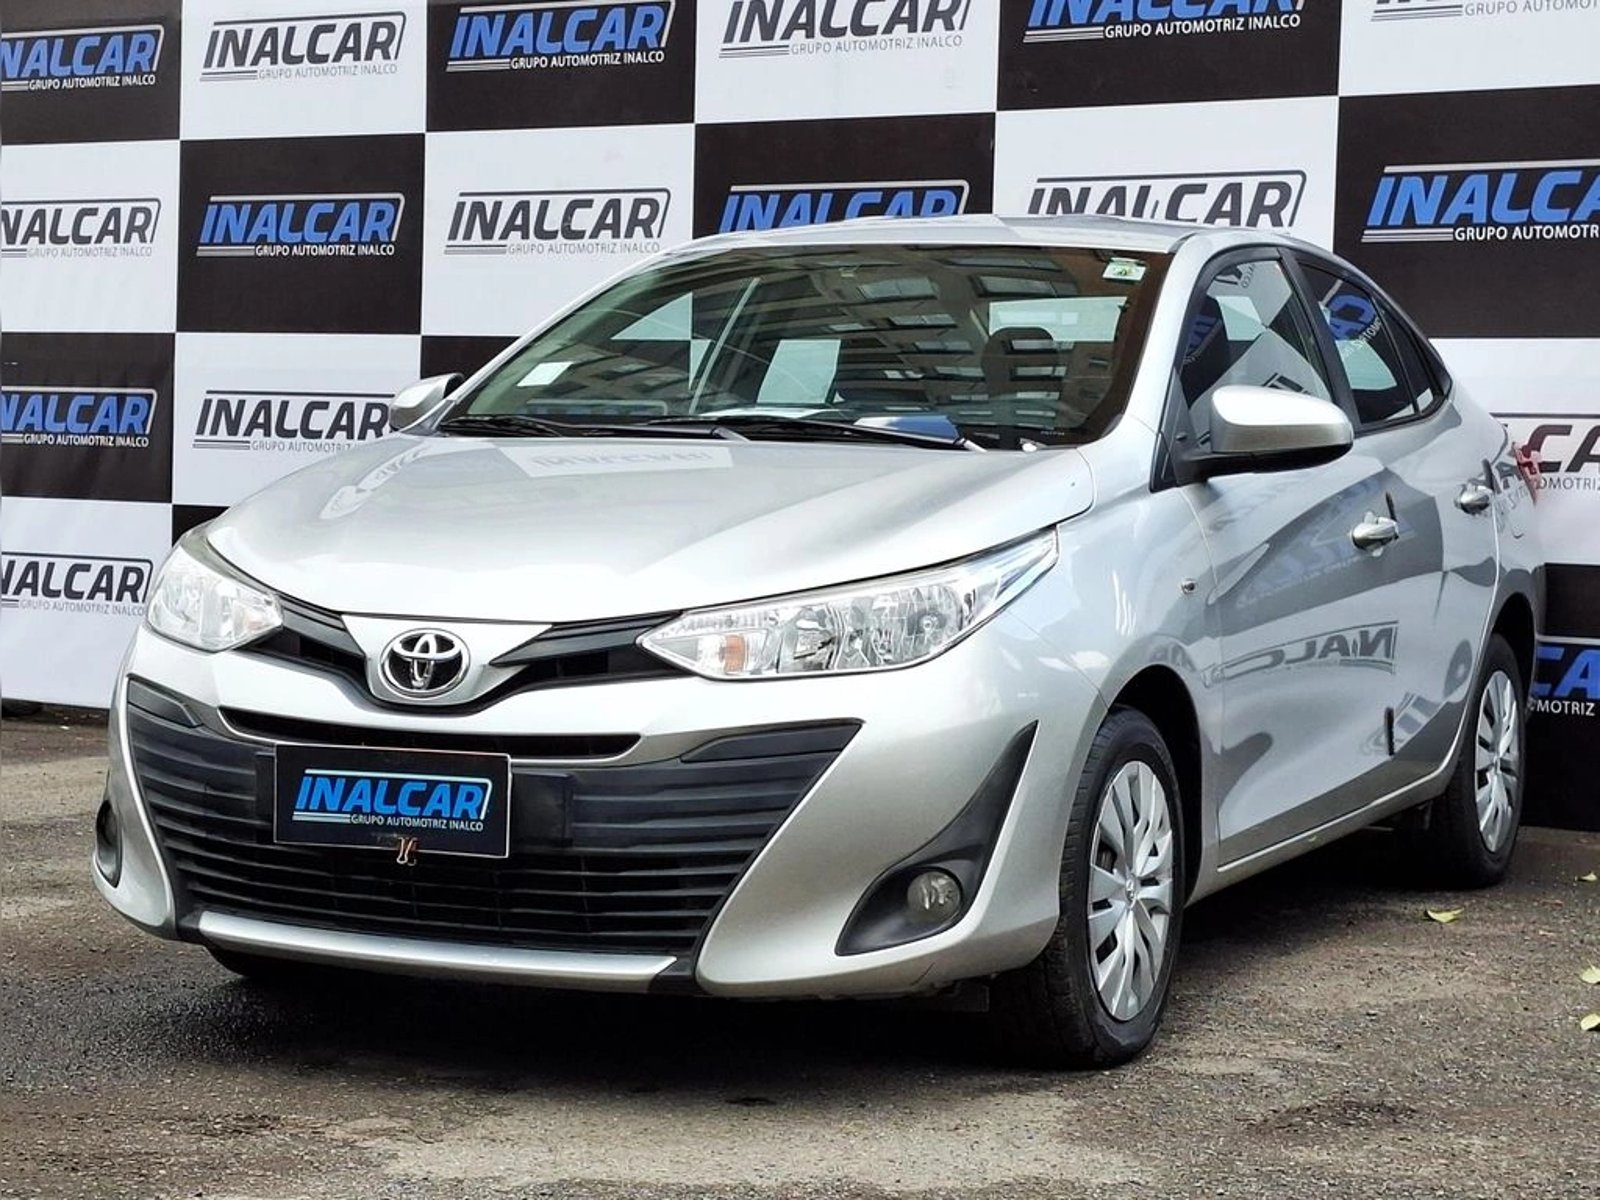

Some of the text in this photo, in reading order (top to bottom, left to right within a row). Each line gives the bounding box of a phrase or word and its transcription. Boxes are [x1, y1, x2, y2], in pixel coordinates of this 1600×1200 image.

[1464, 2, 1518, 17] GRUPO
[723, 0, 961, 44] INALCAR
[1104, 13, 1301, 38] GRUPO AUTOMOTRIZ INALCO
[449, 5, 665, 59] INALCAR
[203, 21, 397, 68] INALCAR
[791, 34, 963, 55] GRUPO AUTOMOTRIZ INALCO
[511, 50, 665, 70] GRUPO AUTOMOTRIZ INALCO
[258, 63, 398, 80] GRUPO AUTOMOTRIZ INALCO
[29, 74, 156, 91] GRUPO AUTOMOTRIZ INALCO
[200, 201, 395, 244] INALCAR
[447, 198, 660, 241] INALCAR
[1454, 226, 1508, 242] GRUPO
[28, 246, 152, 259] GRUPO AUTOMOTRIZ INALCO
[255, 243, 395, 257] GRUPO AUTOMOTRIZ INALCO
[508, 241, 660, 255] GRUPO AUTOMOTRIZ INALCO
[195, 398, 391, 441] INALCAR
[24, 433, 149, 449] GRUPO AUTOMOTRIZ INALCO
[251, 440, 285, 451] GRUPO
[20, 600, 146, 617] GRUPO AUTOMOTRIZ INALCO
[294, 776, 484, 820] INALCAR
[350, 814, 484, 832] GRUPO AUTOMOTRIZ INALCO
